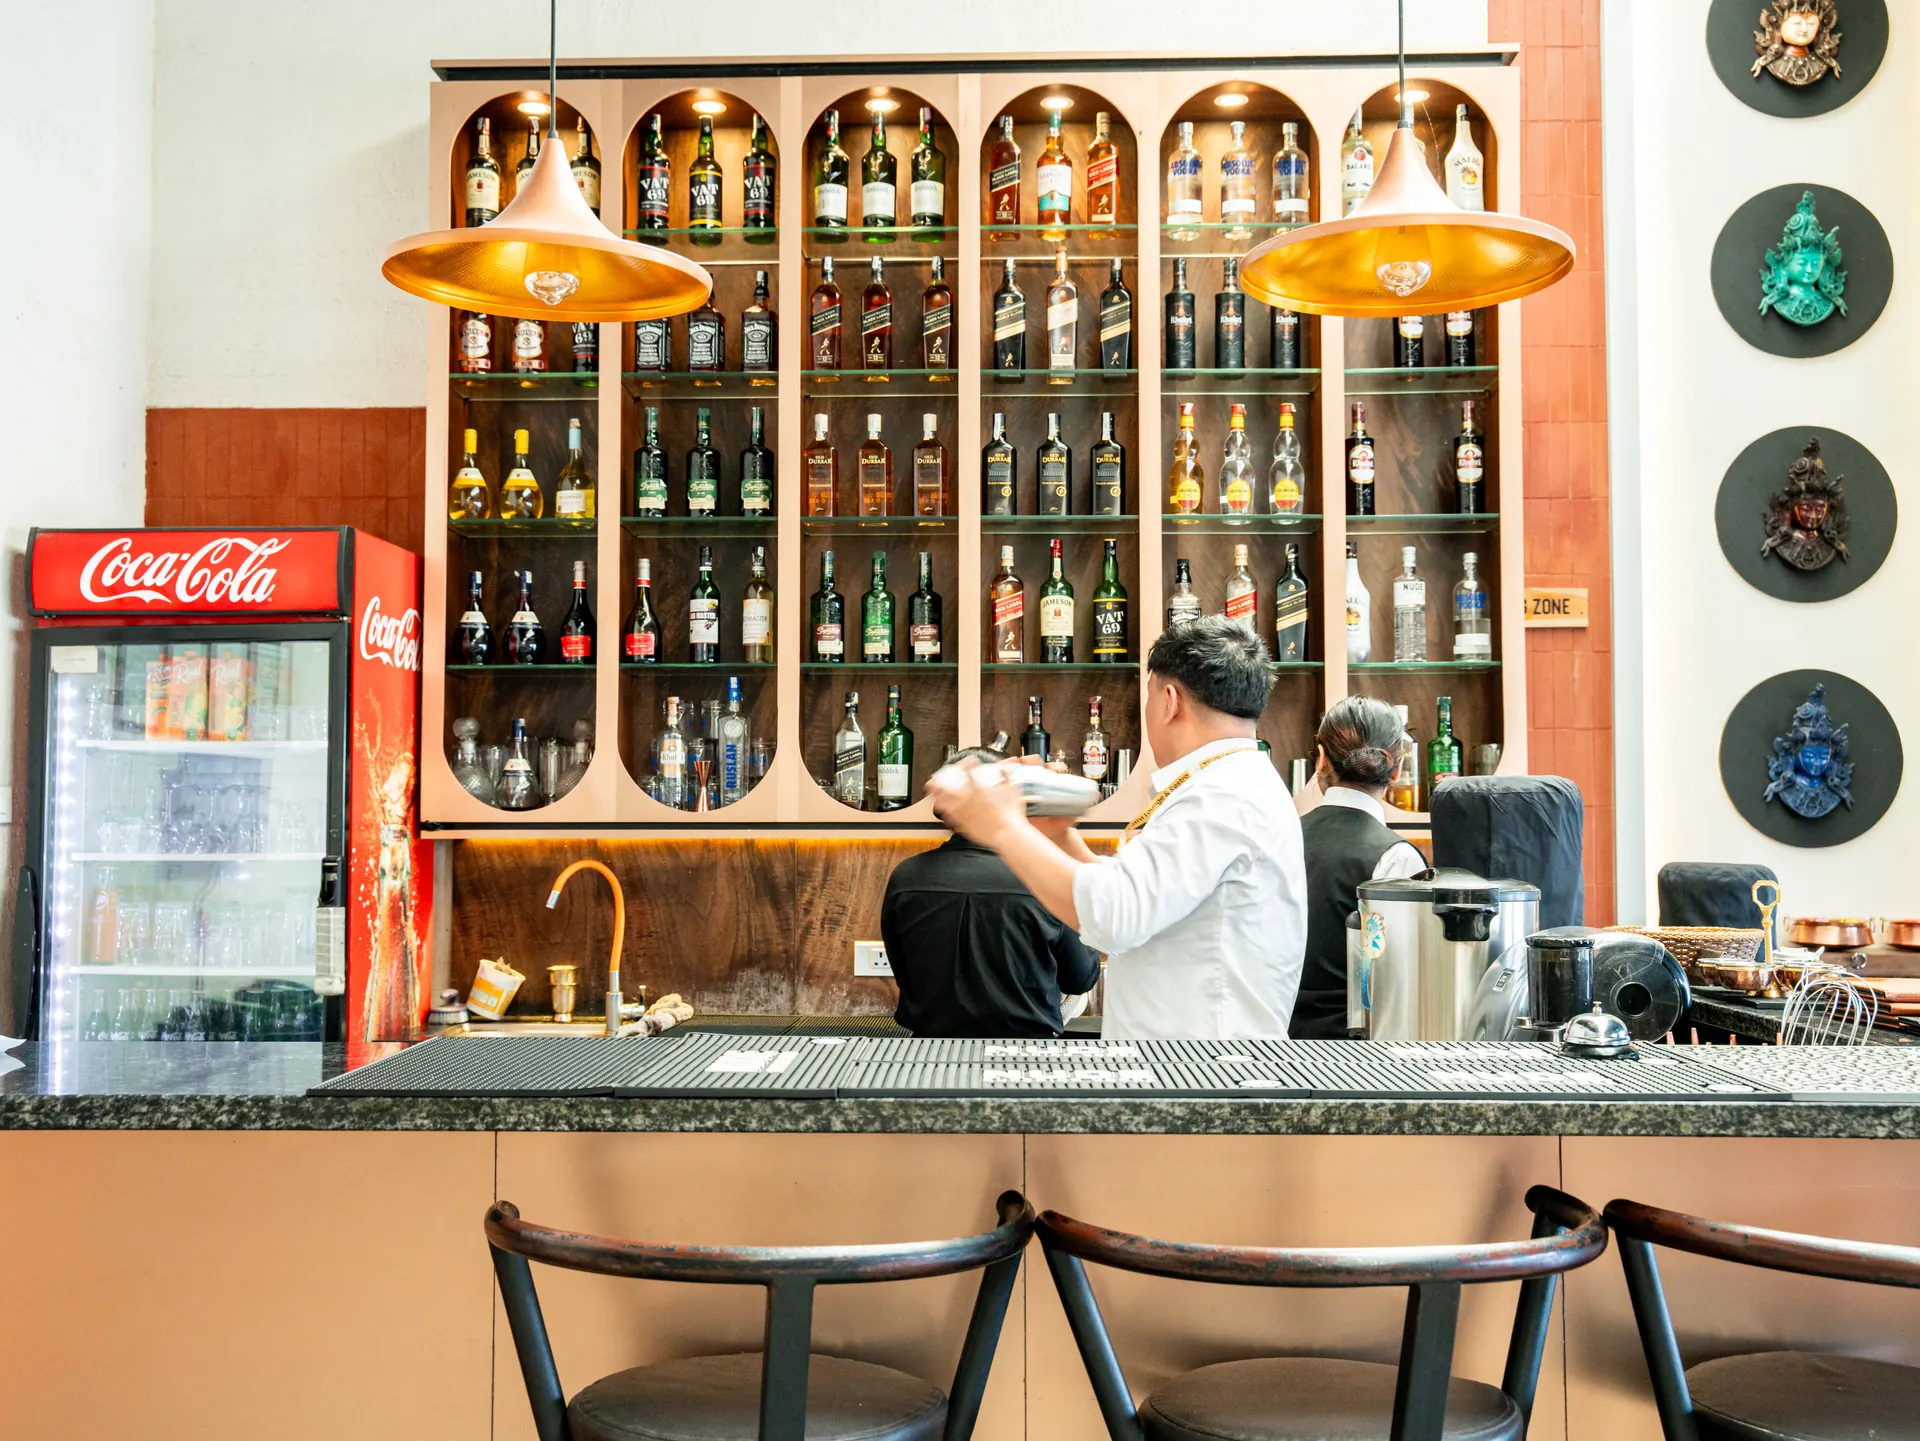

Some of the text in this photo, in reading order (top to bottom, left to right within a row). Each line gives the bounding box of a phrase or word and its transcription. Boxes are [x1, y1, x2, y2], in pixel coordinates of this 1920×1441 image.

[1172, 168, 1198, 176] VODKA
[1226, 168, 1251, 176] VODKA
[640, 177, 669, 190] VAT
[744, 175, 772, 189] VAT
[647, 188, 667, 200] 69
[690, 184, 718, 197] VAT
[750, 187, 769, 199] 69
[696, 194, 715, 206] 69
[574, 332, 593, 344] 69
[80, 537, 292, 604] Coca-Cola
[1006, 600, 1022, 610] LABEL
[1042, 599, 1072, 608] JAMESON
[1238, 599, 1254, 609] LABEL
[1533, 598, 1570, 614] ZONE
[1096, 611, 1124, 624] VAT
[1102, 622, 1120, 634] 69
[726, 744, 737, 789] RUSLAN
